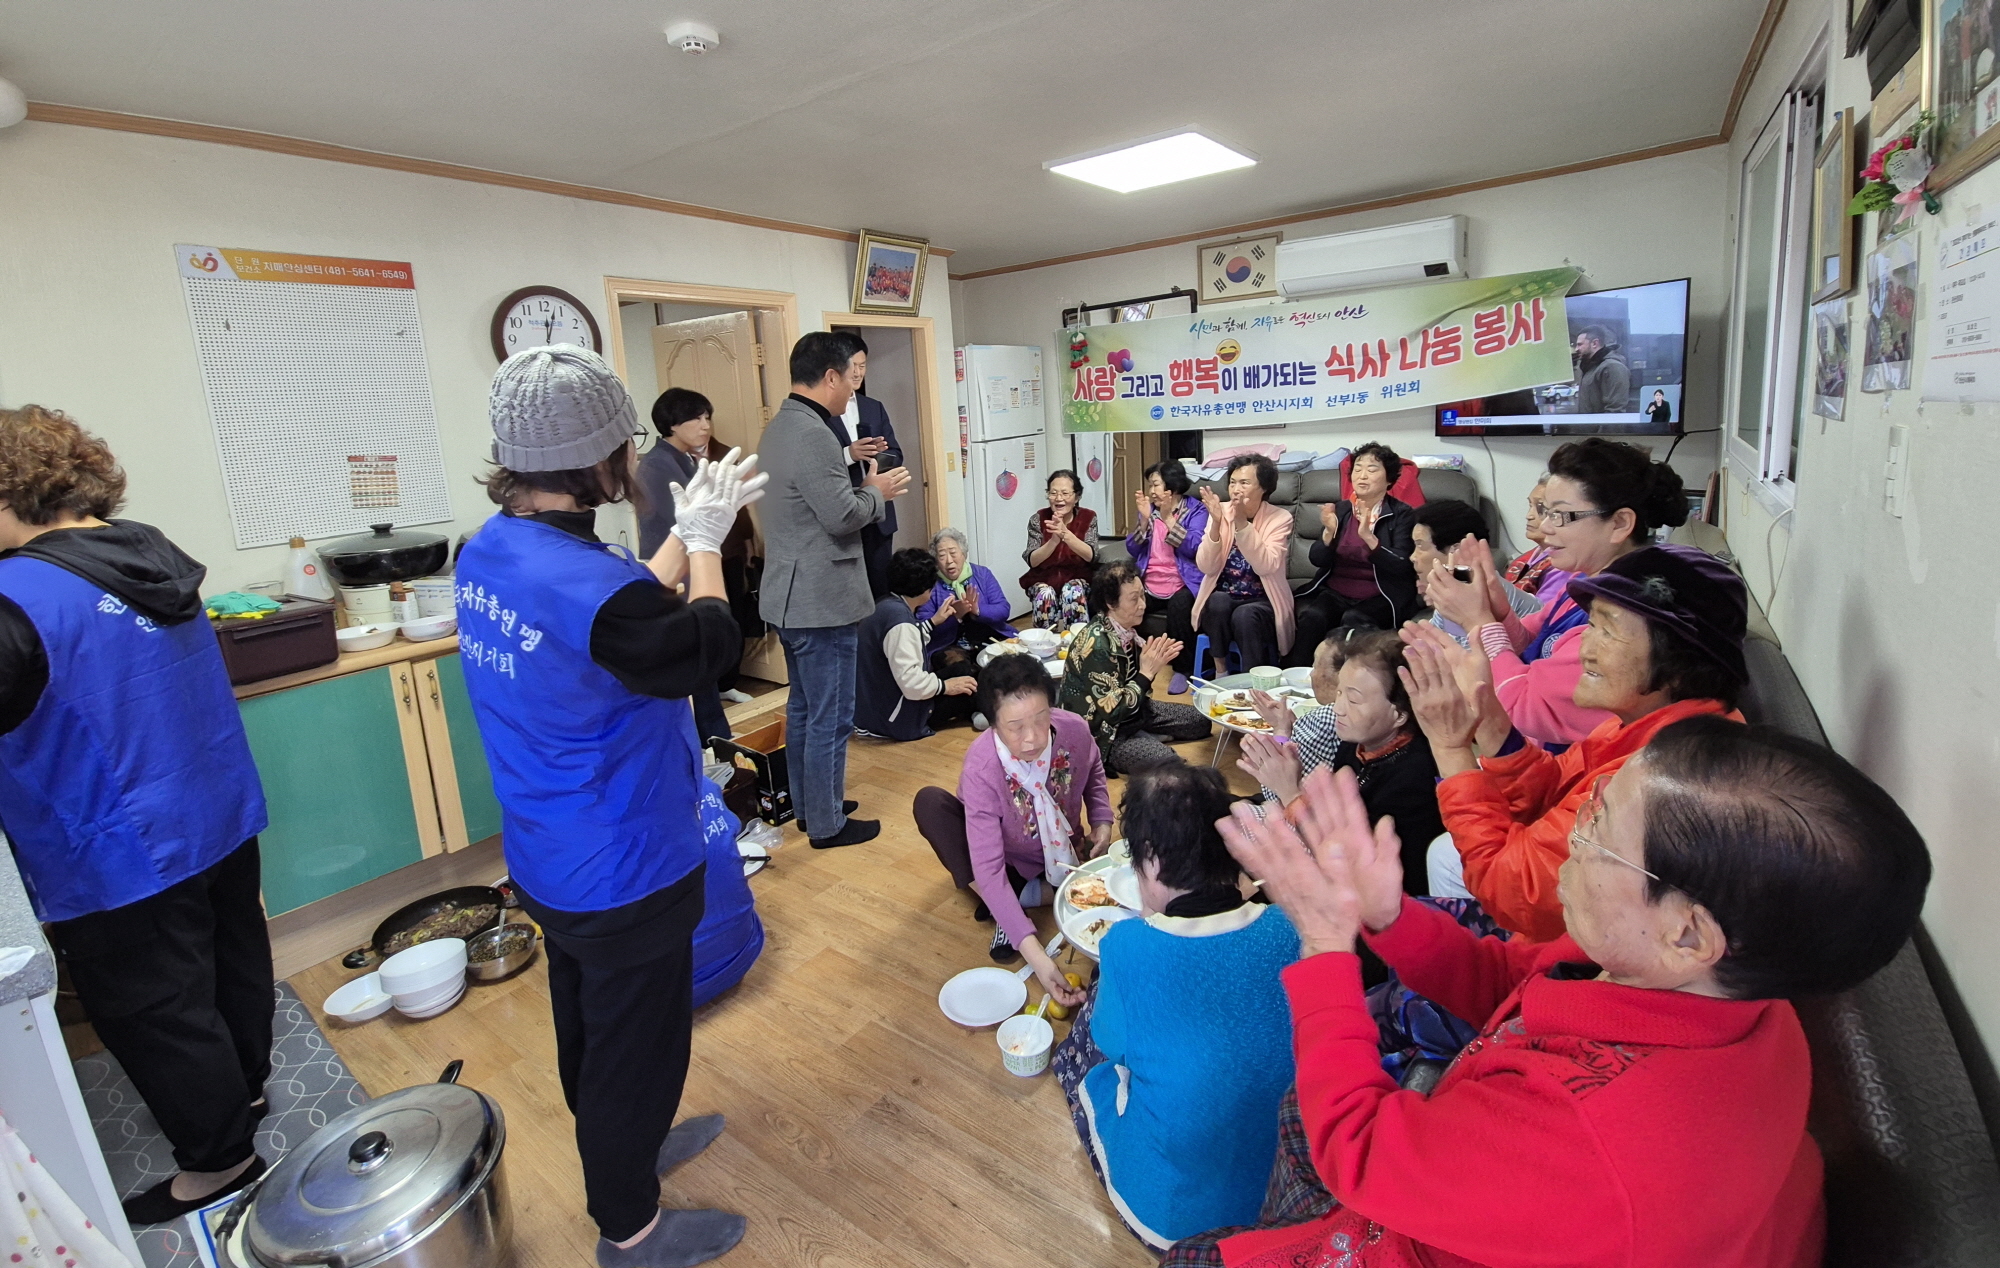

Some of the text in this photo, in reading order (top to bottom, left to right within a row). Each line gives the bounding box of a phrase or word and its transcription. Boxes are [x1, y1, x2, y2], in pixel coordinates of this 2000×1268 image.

[236, 265, 262, 274] 보건소
[522, 304, 531, 316] 11
[539, 301, 550, 312] 12
[559, 306, 564, 317] 1
[509, 316, 523, 329] 10
[572, 318, 579, 330] 2
[1189, 318, 1223, 339] 시민과
[1289, 311, 1331, 328] 혁신도시
[1334, 304, 1370, 320] 안산
[508, 334, 517, 346] 9
[577, 335, 586, 348] 3
[1073, 365, 1117, 401] 사랑
[1121, 374, 1166, 399] 그리고
[1169, 356, 1238, 397] 행복이
[1243, 361, 1318, 390] 배가되는
[1324, 338, 1391, 384] 식사
[1399, 325, 1463, 372] 나눔
[1473, 297, 1546, 356] 봉사
[1170, 380, 1421, 418] 한국자유총연맹 안산시지회 선부1동 위원회
